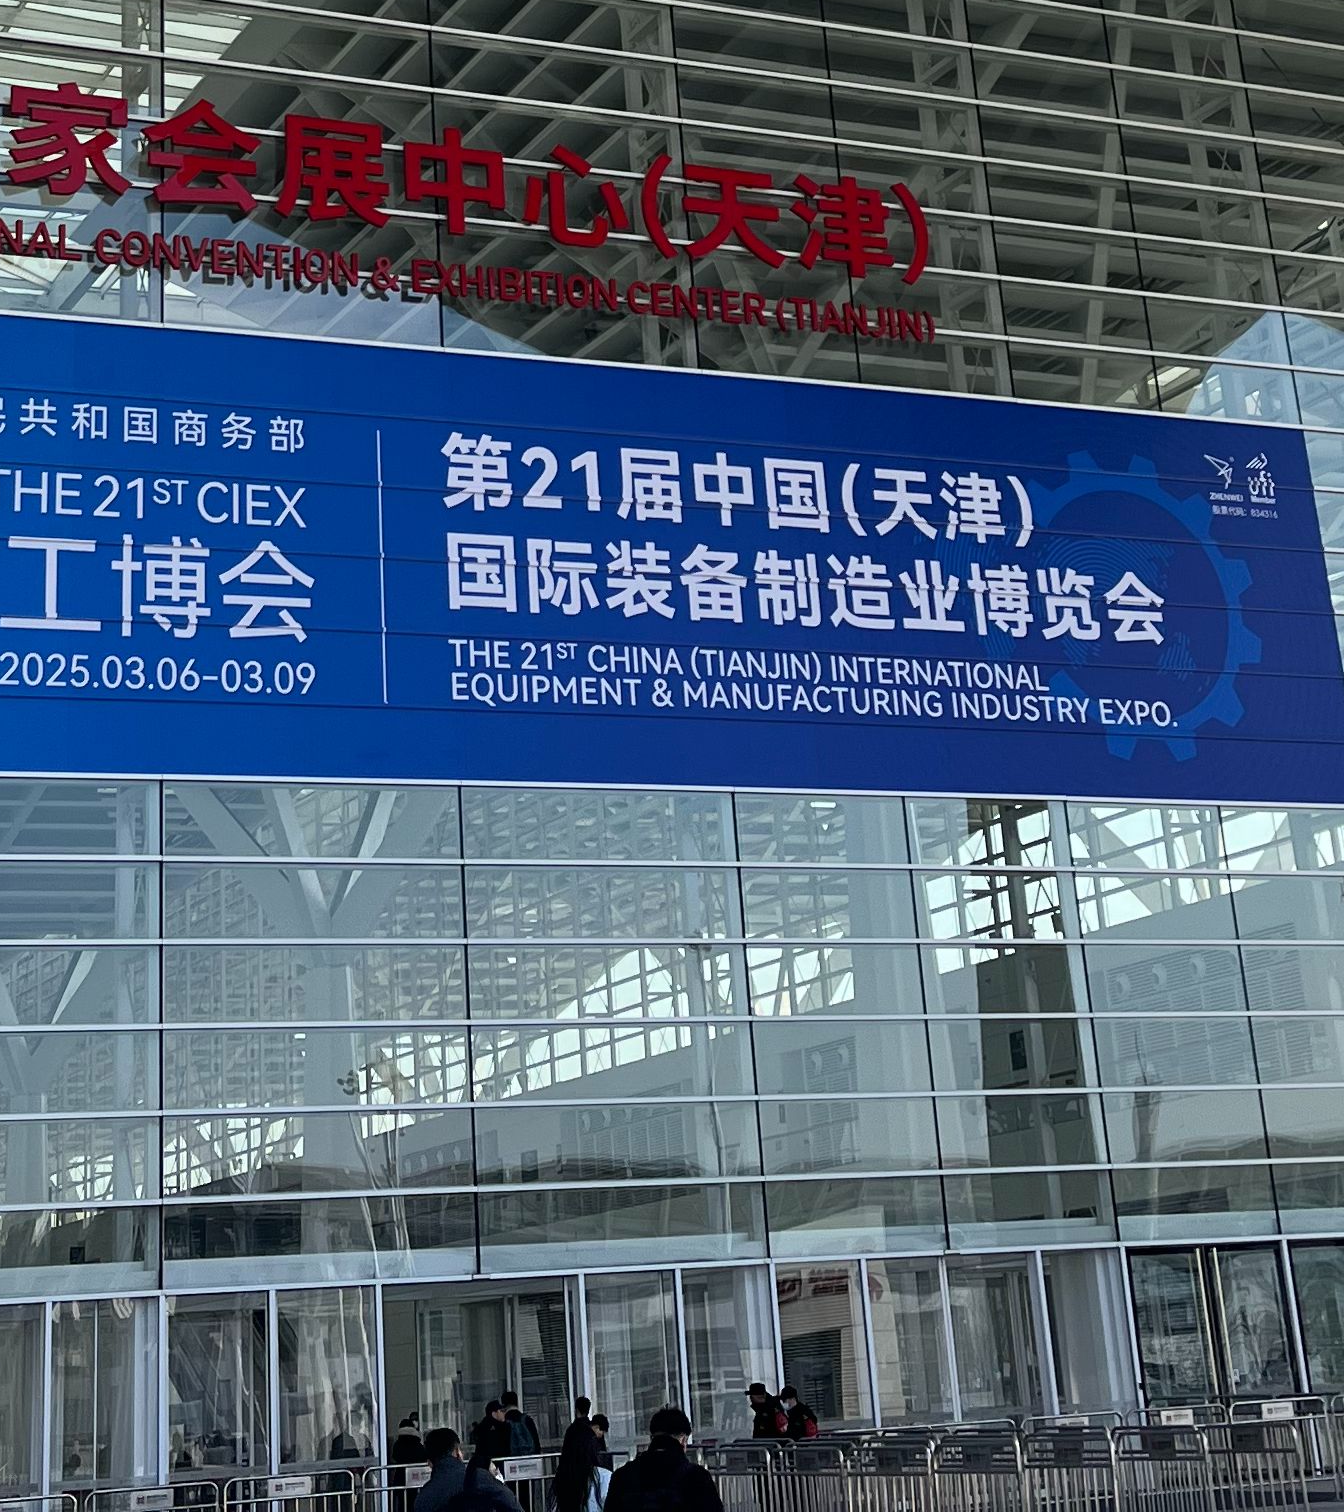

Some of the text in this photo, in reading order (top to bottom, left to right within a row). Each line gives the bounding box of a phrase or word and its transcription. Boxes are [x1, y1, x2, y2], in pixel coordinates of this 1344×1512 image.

[94, 229, 359, 287] CONVENTION
[371, 256, 400, 291] &
[411, 258, 617, 311] EXHIBITION
[627, 281, 769, 327] CENTER
[775, 295, 935, 344] (TIANJIN)
[93, 476, 189, 519] 21ST
[197, 481, 307, 528] CIEX
[440, 431, 1034, 548] 第21届中国(天津)
[446, 532, 1165, 645] 国际装备制造业博览会
[448, 639, 1051, 694] THE 21ST CHINA (TIANJIN) INTERNATIONAL
[451, 672, 1179, 728] EQUIPMENT & MANUFACTURING INDUSTRY EXPO.
